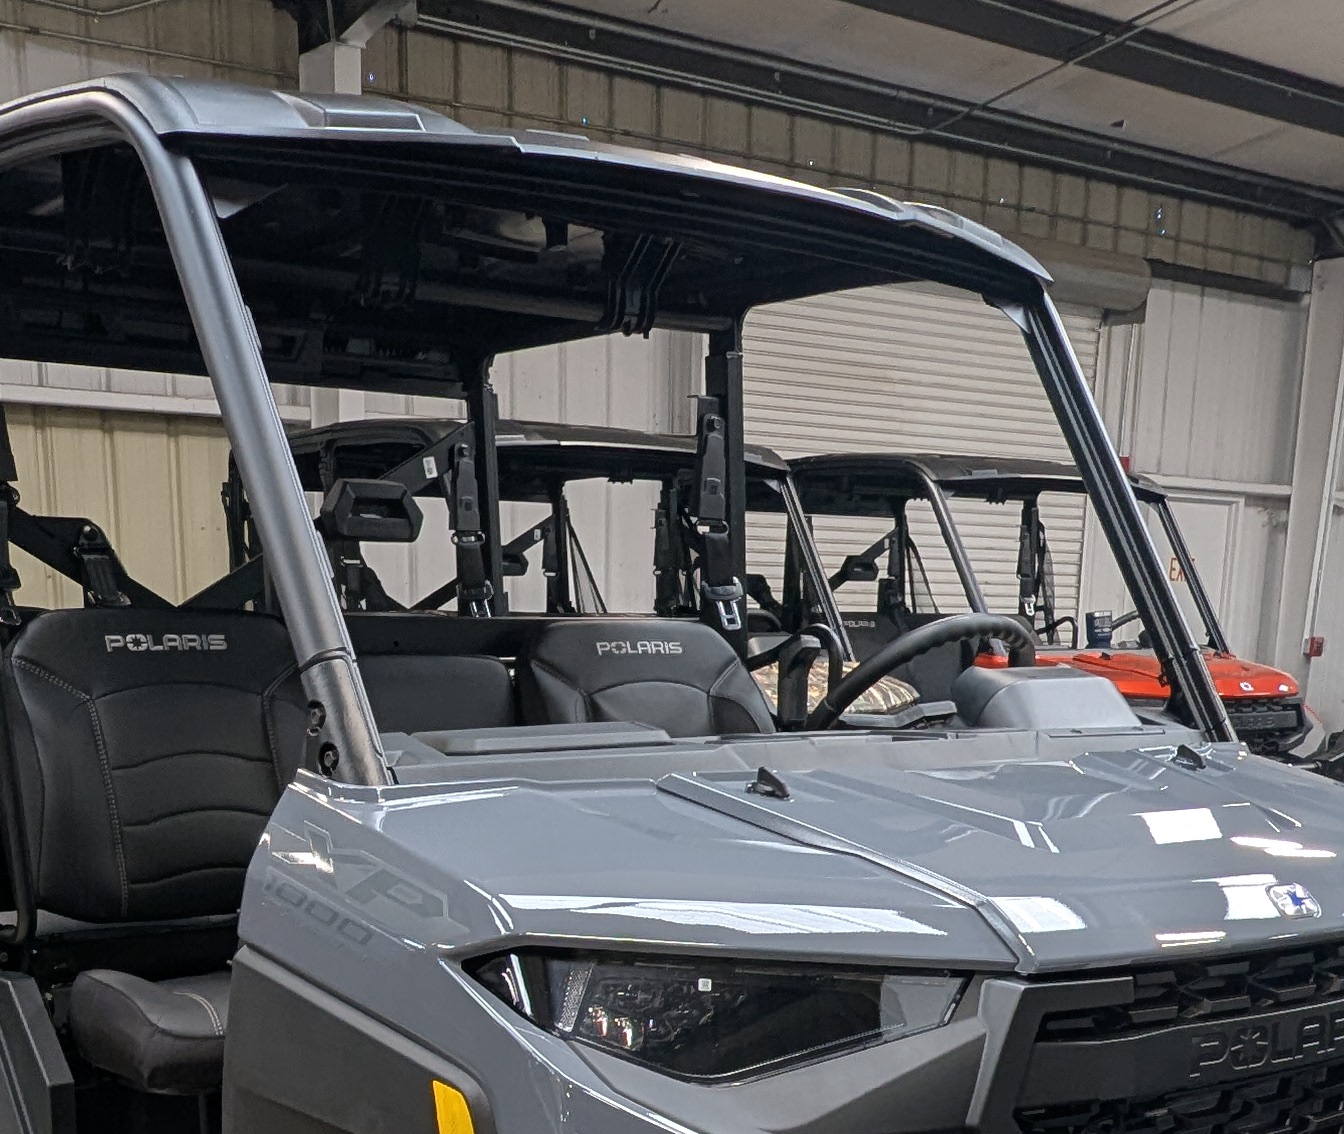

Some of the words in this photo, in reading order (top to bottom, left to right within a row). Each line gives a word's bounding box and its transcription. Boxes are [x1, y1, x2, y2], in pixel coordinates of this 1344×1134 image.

[104, 633, 228, 653] POLARIS
[596, 640, 683, 656] POLARIS
[270, 819, 449, 919] XP
[262, 876, 375, 946] 1000
